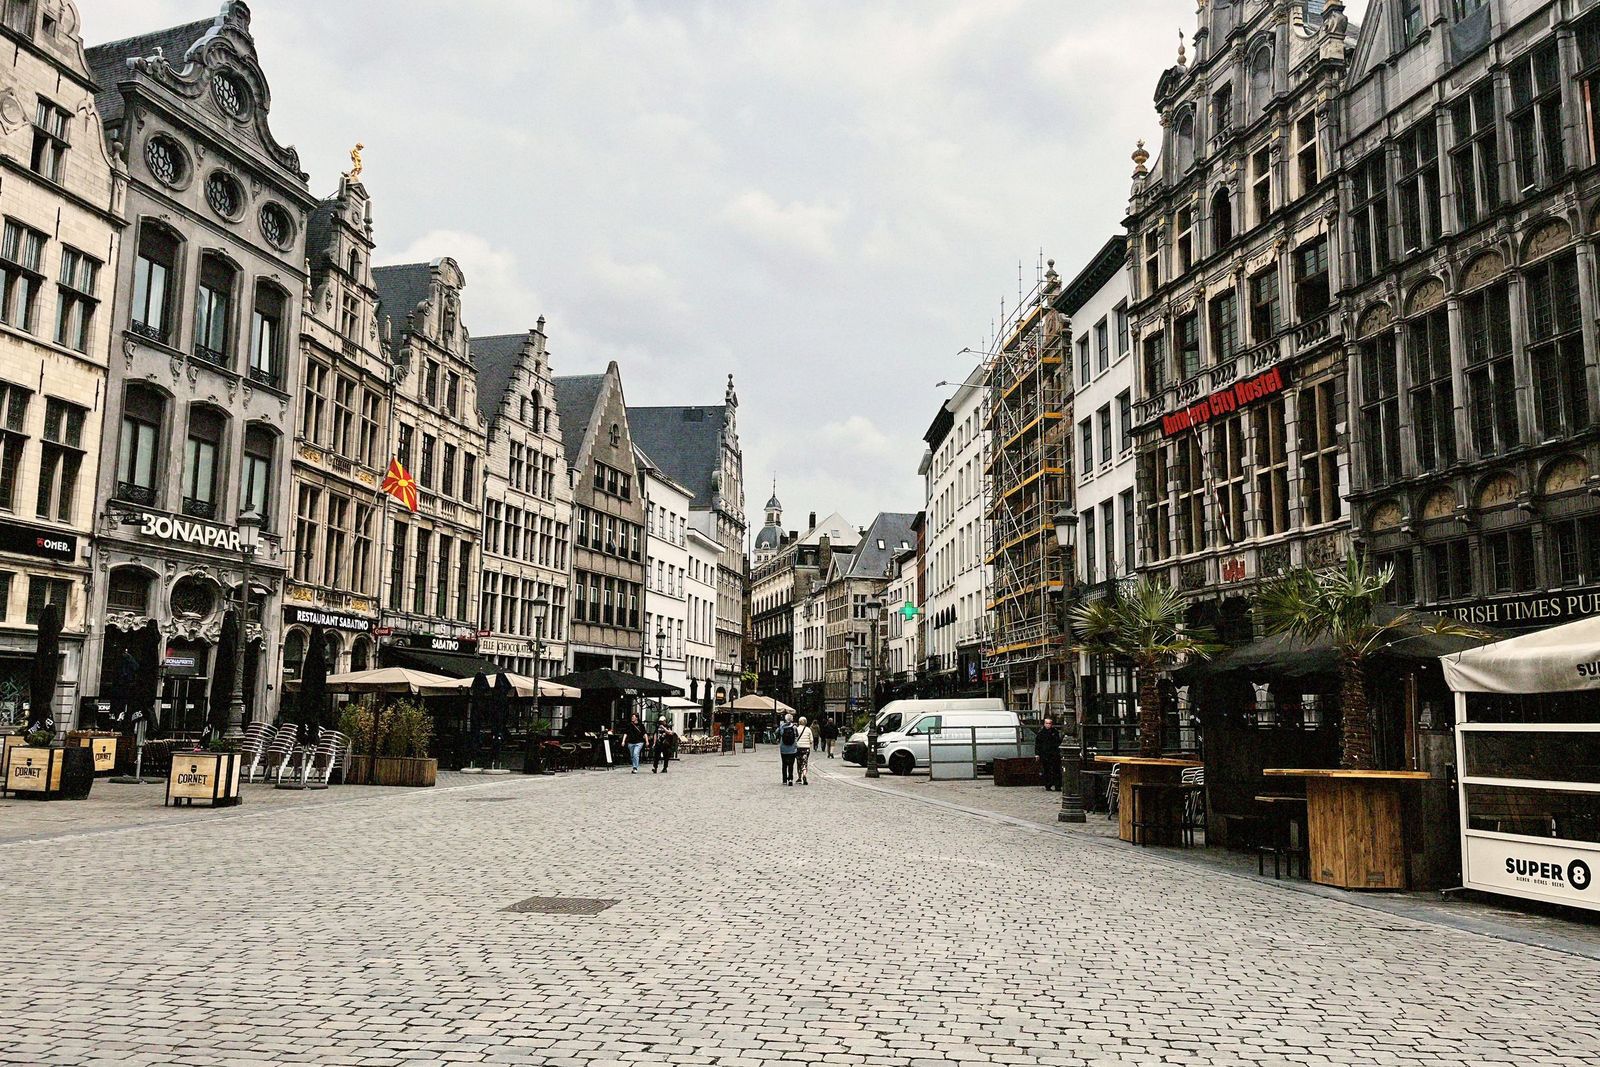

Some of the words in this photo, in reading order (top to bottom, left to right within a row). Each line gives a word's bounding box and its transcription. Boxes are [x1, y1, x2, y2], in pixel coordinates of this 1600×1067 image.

[1162, 401, 1211, 436] Antwerp
[1208, 389, 1236, 417] City
[1234, 366, 1283, 405] Hostel
[141, 512, 264, 555] BONAPARE
[1454, 604, 1498, 624] IRISH
[1502, 598, 1561, 621] TIMES
[297, 610, 339, 627] RESTAURANT
[339, 616, 369, 630] SABATINO
[432, 638, 459, 651] SABATINO
[483, 640, 494, 650] ELLE
[1576, 661, 1600, 676] SU
[95, 752, 112, 761] CORNET
[15, 766, 41, 778] CORNET
[177, 773, 208, 785] CORNET
[1505, 857, 1564, 881] SUPER
